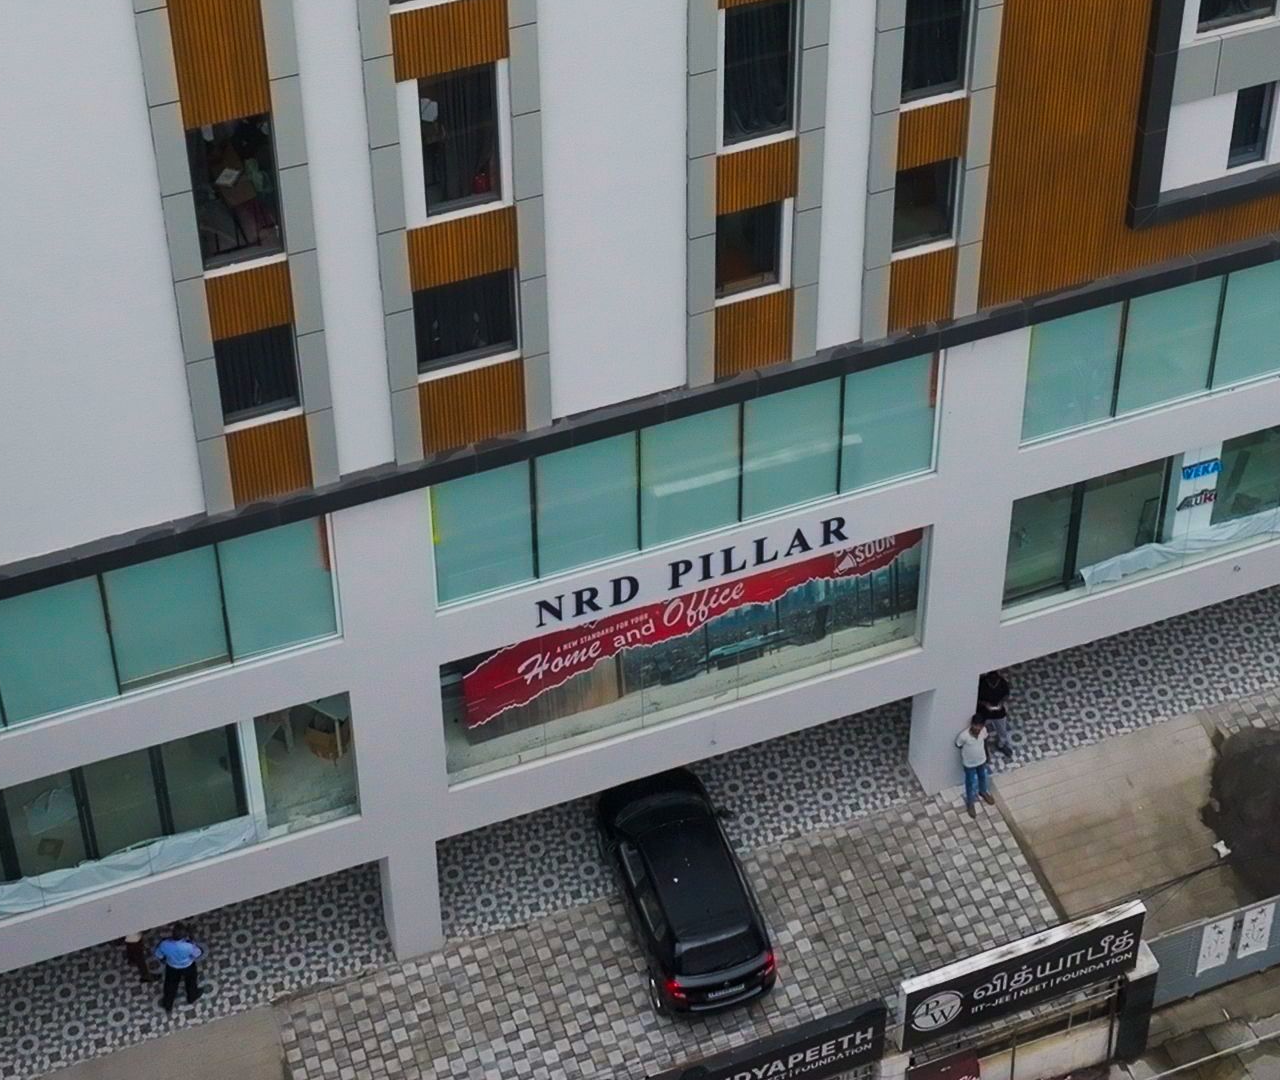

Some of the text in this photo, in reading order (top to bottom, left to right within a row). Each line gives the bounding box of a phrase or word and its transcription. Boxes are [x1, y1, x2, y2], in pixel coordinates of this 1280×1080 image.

[535, 516, 849, 628] NRD PILLAR
[517, 582, 745, 685] Home and Office
[580, 625, 615, 645] STANDARD
[971, 952, 1133, 1014] IIT-JEE NEET FOUNDATION
[724, 1027, 874, 1080] DYAPEETH
[795, 1043, 873, 1076] FOUNDATION
